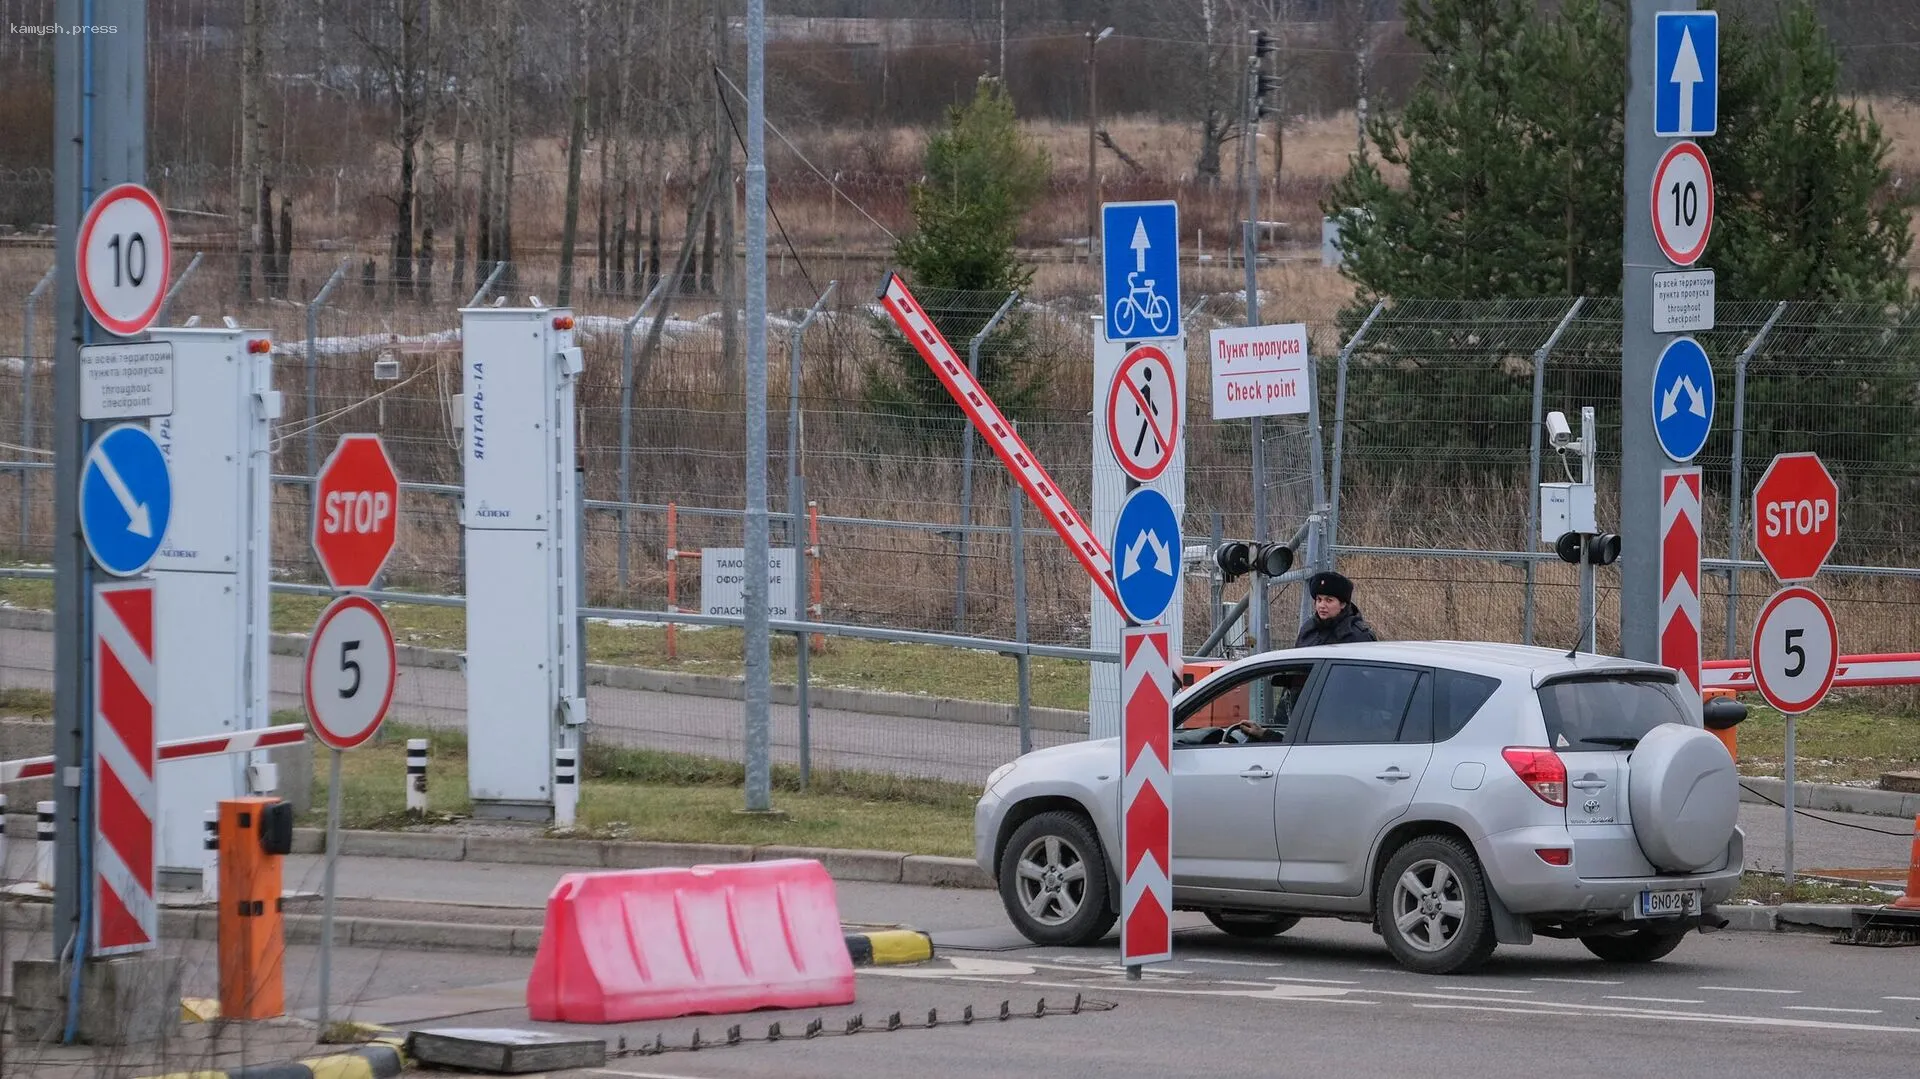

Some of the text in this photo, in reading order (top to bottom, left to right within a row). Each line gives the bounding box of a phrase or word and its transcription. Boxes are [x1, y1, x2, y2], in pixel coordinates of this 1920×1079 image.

[1671, 180, 1697, 227] 10
[107, 232, 146, 288] 10
[1663, 278, 1678, 288] всей
[1679, 278, 1714, 288] территории
[1659, 289, 1709, 301] пункта пропуска
[1667, 303, 1701, 314] throughout
[1667, 314, 1701, 324] checkpoint
[1218, 338, 1300, 364] Пункт пропуска
[81, 356, 93, 364] на
[119, 352, 172, 365] территории
[89, 366, 165, 380] пункта пропуска
[101, 383, 152, 396] throughout
[1227, 378, 1296, 403] Check point
[102, 397, 151, 409] checkpoint
[473, 362, 484, 460] ЯНТАРЬ-1А
[323, 490, 391, 534] STOP
[1765, 498, 1830, 538] STOP
[716, 559, 782, 569] ТАМООЕ
[716, 575, 782, 584] ОФОРИЕ
[1784, 628, 1806, 678] 5
[338, 640, 361, 699] 5
